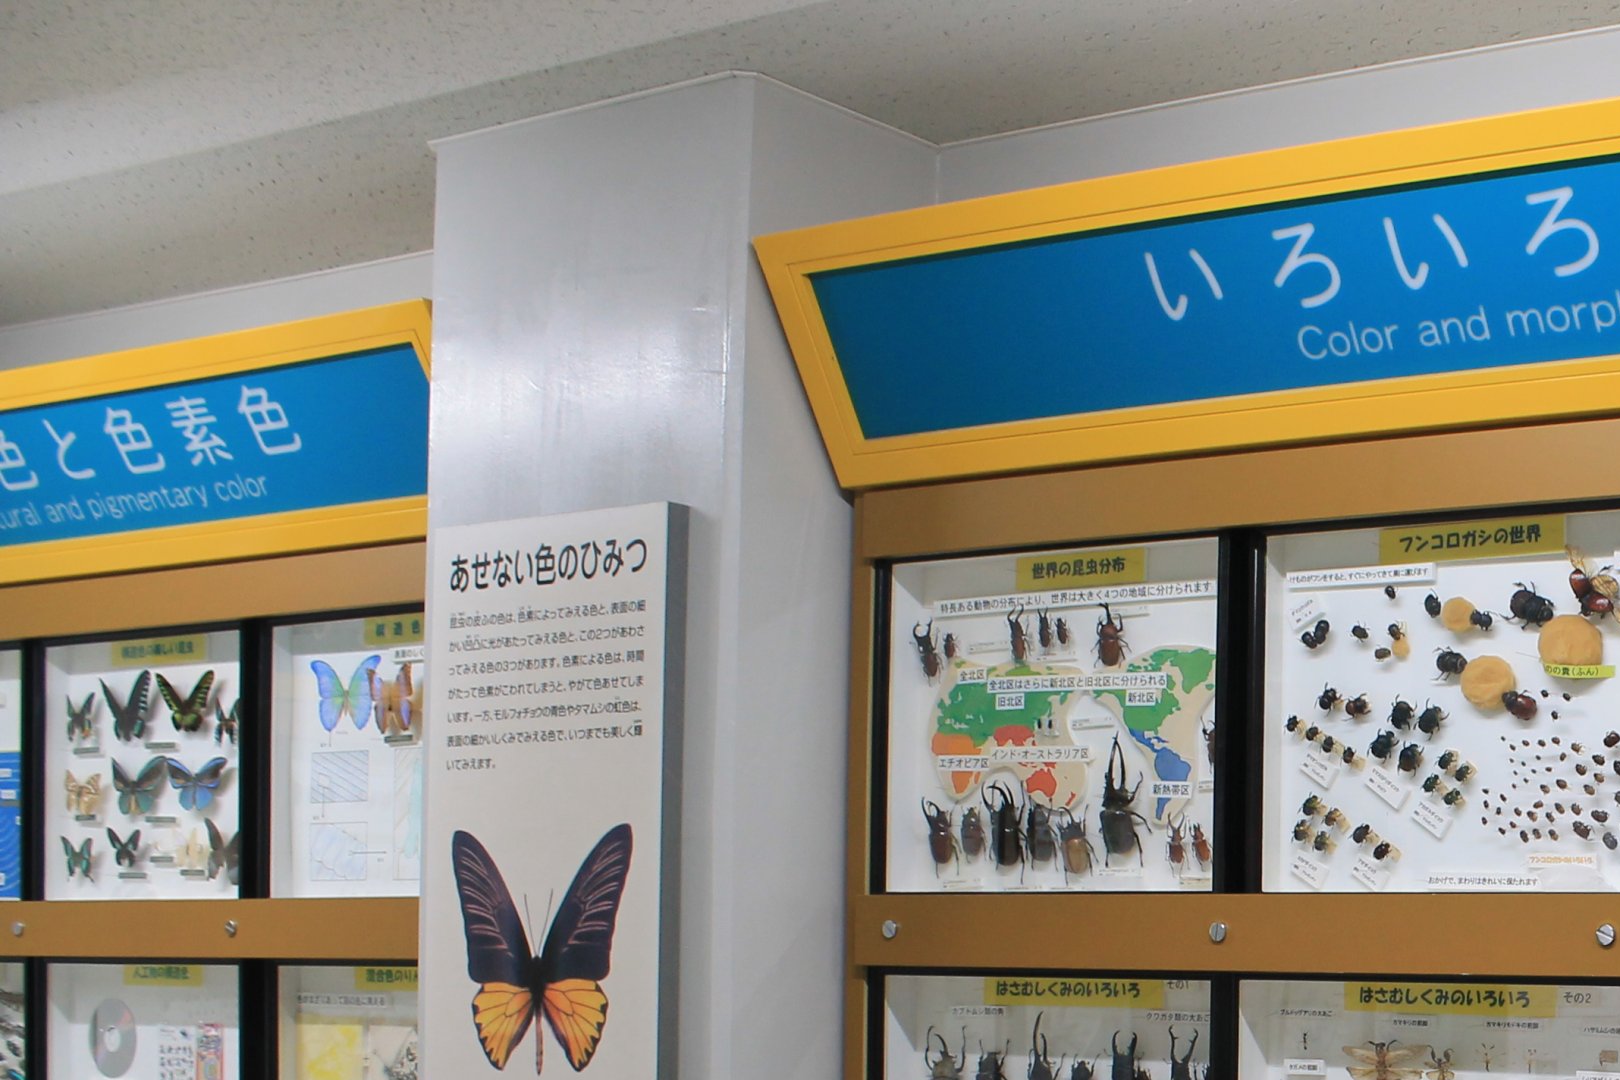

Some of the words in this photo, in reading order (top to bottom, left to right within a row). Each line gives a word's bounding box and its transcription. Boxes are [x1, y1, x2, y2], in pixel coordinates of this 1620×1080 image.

[1297, 317, 1398, 361] Color
[1419, 305, 1489, 348] and
[44, 495, 85, 523] and
[88, 484, 209, 520] pigmentary
[214, 473, 269, 501] color
[1400, 524, 1542, 553] フンコロガシの世界
[450, 539, 647, 592] あせない色のひみつ
[1032, 557, 1126, 579] 世界の昆虫分布
[959, 669, 986, 680] 全北区
[989, 675, 1166, 691] 全北区はさらに新北区と旧北区に分けられる
[998, 695, 1024, 707] 旧北区
[1127, 692, 1157, 703] 新北区
[992, 748, 1089, 760] インド・オーストラリア区
[446, 758, 495, 770] いてみえます。
[939, 757, 989, 768] エチオピア区
[1153, 784, 1190, 796] 新熱帯区
[996, 981, 1140, 998] はさむしくみのいろいろ
[1360, 987, 1530, 1007] はさむしくみのいろいろ
[1564, 992, 1591, 1004] その2
